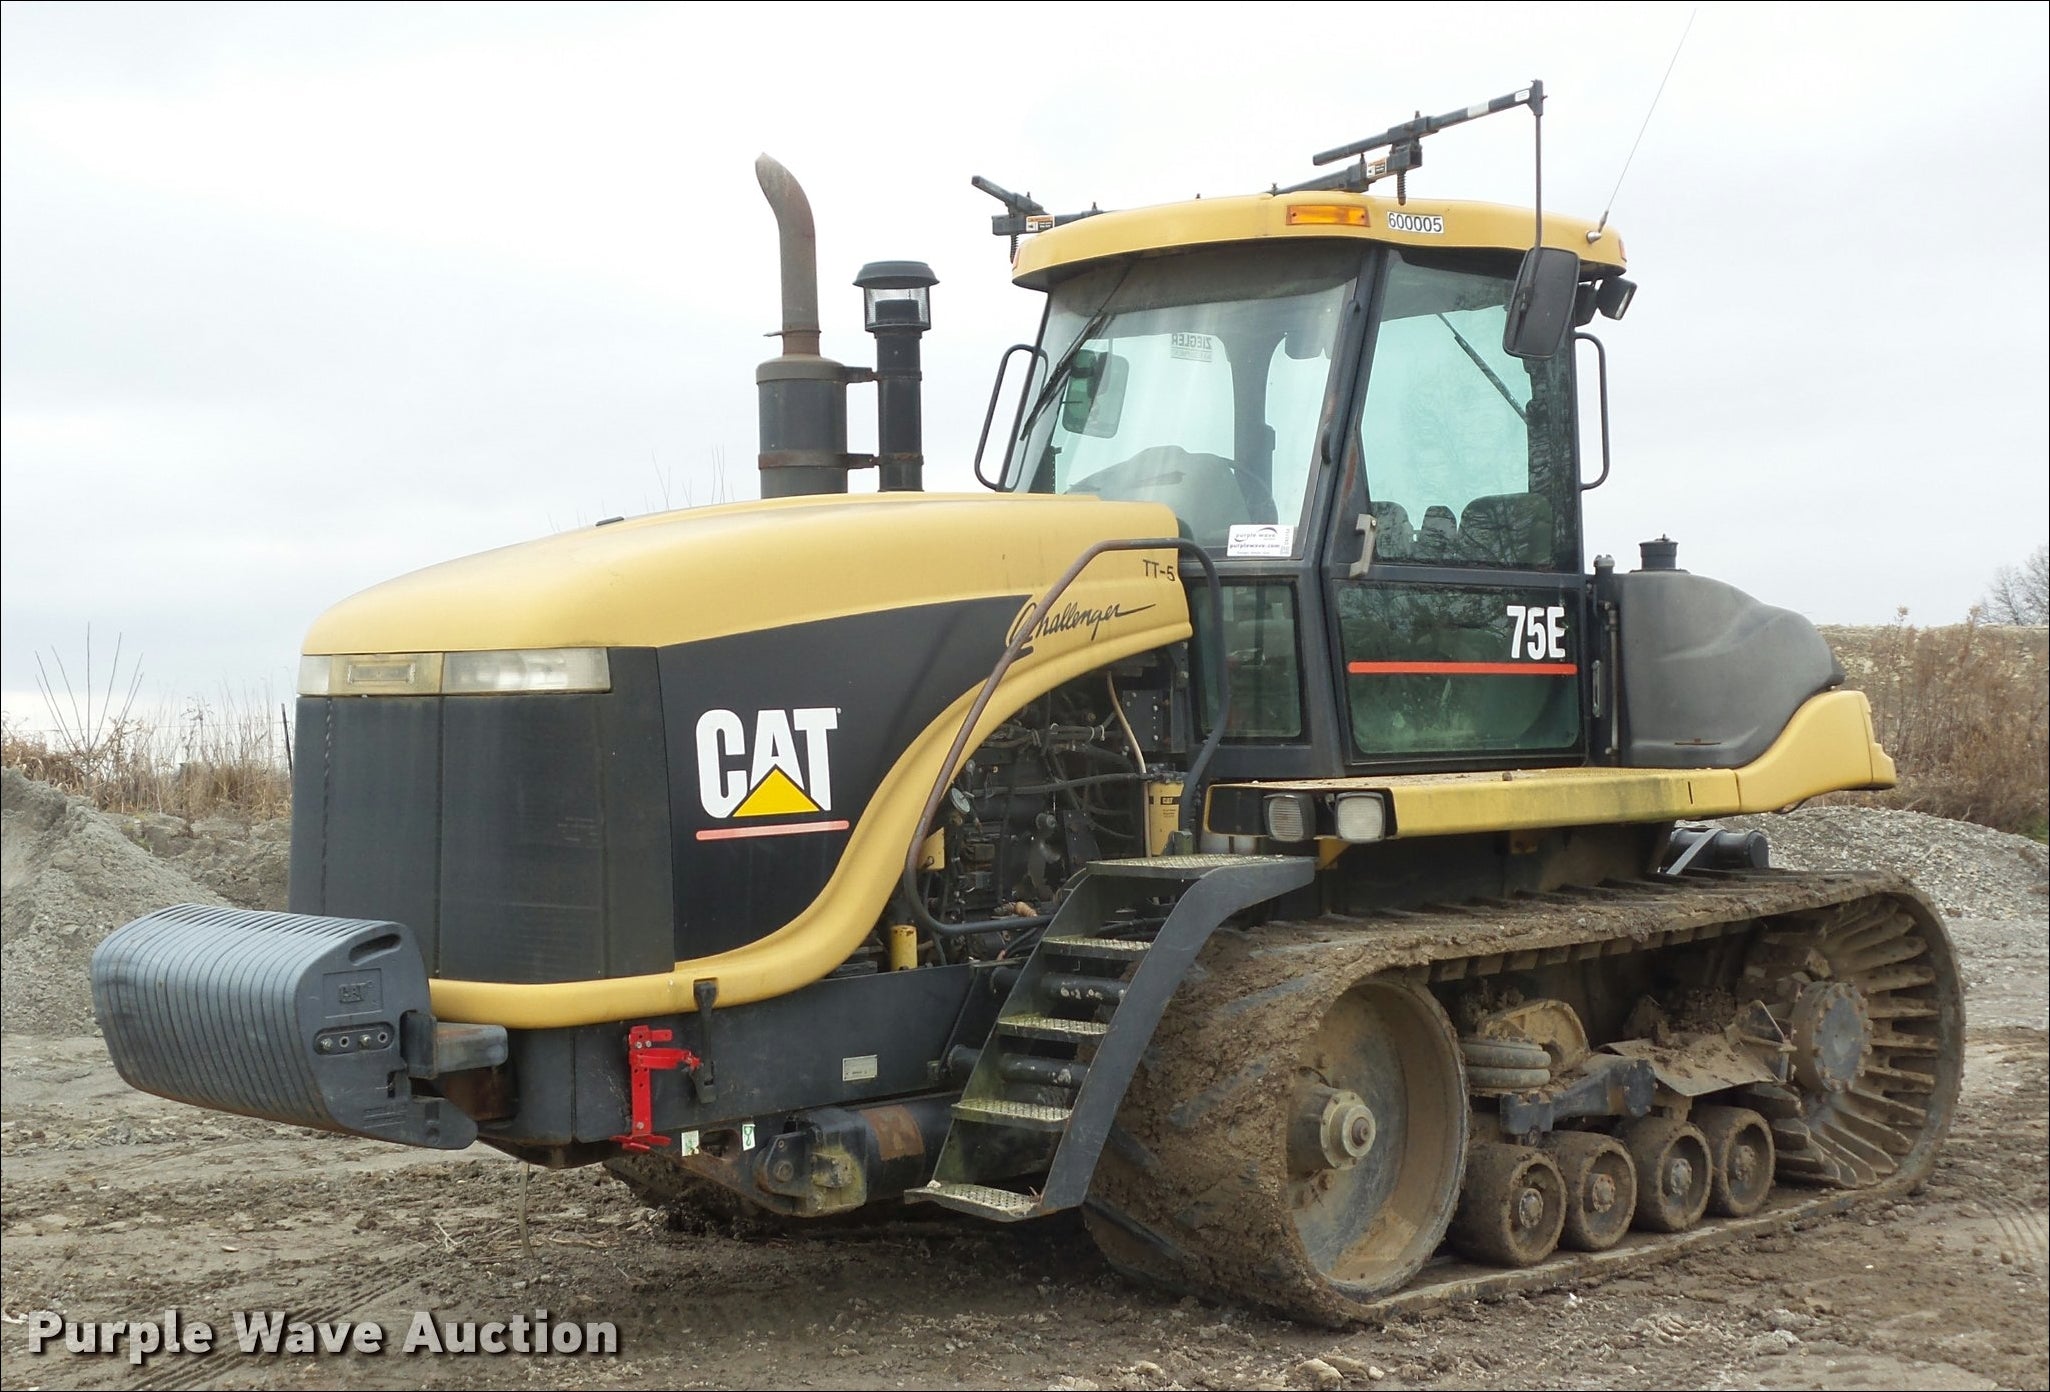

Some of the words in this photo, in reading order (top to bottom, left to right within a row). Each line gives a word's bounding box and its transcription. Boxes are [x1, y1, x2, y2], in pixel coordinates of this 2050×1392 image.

[1388, 213, 1442, 232] 600005
[1236, 531, 1257, 540] purple
[1143, 559, 1175, 582] TT-5
[1507, 605, 1565, 660] 75E
[696, 708, 838, 818] CAT
